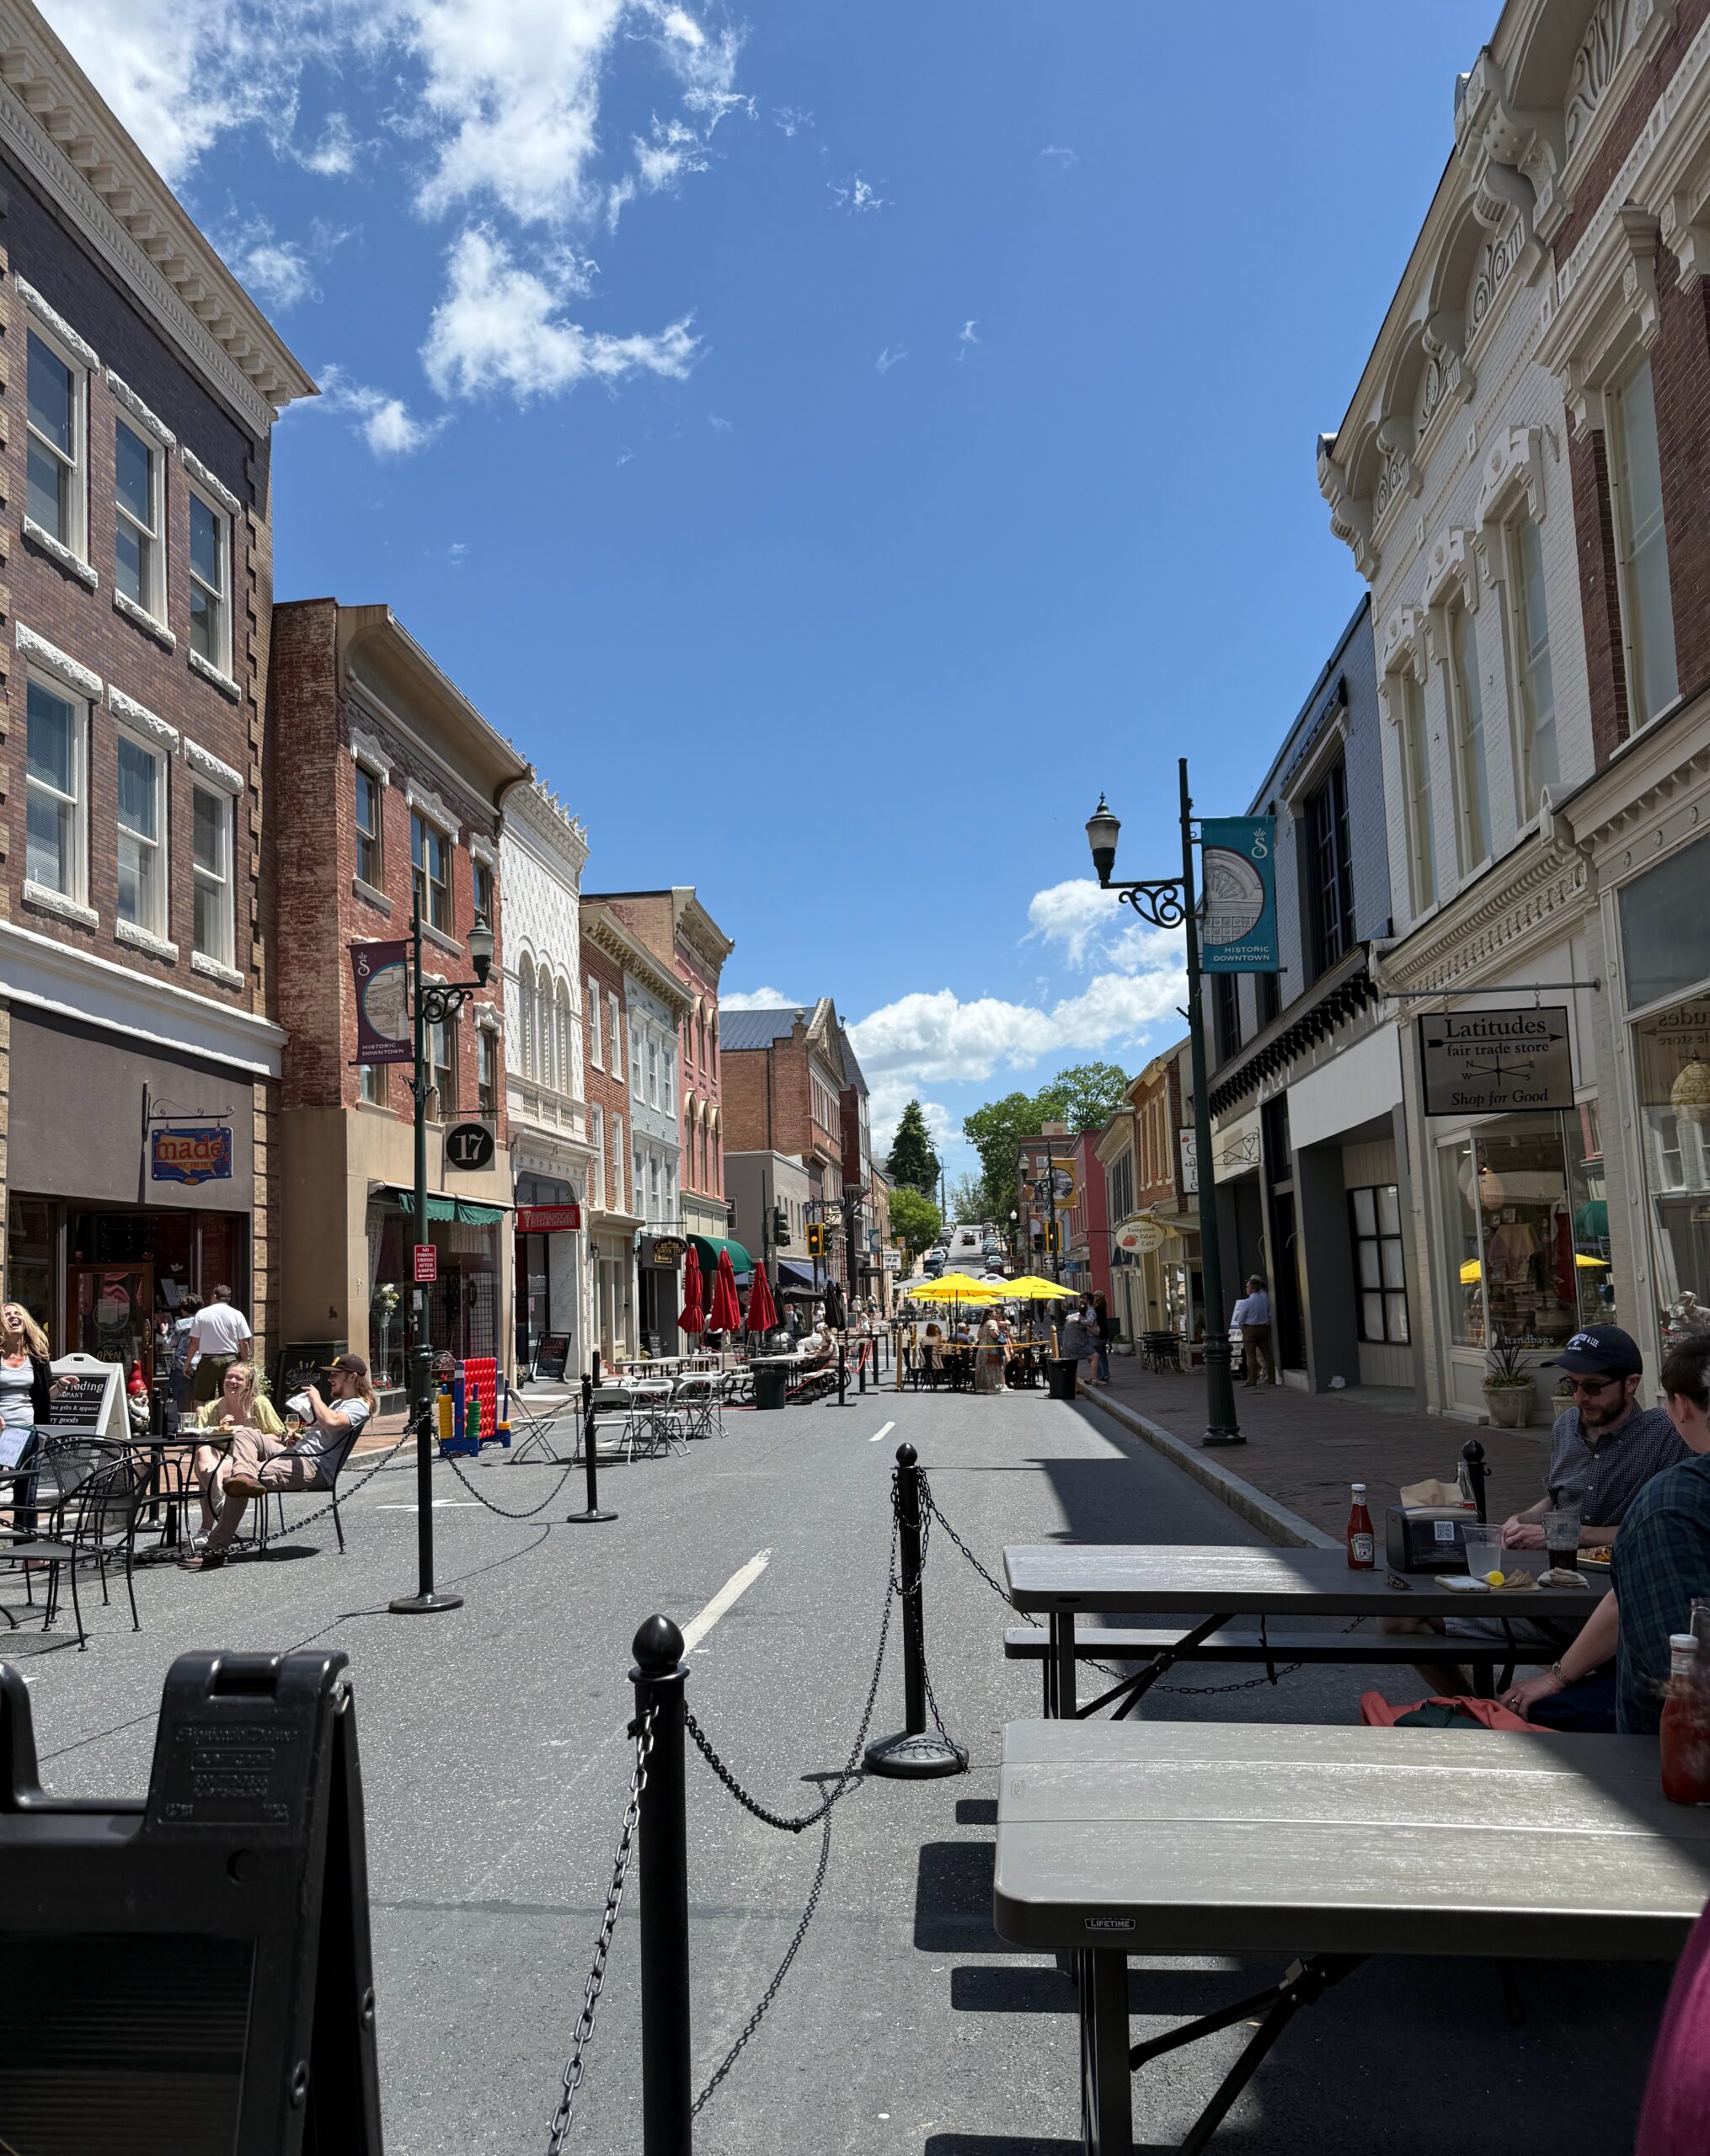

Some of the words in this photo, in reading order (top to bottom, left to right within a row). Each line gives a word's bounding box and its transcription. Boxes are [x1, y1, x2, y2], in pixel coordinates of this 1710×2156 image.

[1251, 836, 1268, 859] S
[1444, 1015, 1547, 1038] Latitudes
[1447, 1044, 1471, 1057] fair
[1476, 1042, 1510, 1055] trade
[1515, 1043, 1550, 1054] store
[1462, 1072, 1472, 1081] W
[1525, 1073, 1531, 1081] S
[1451, 1092, 1485, 1107] Shop
[1488, 1091, 1508, 1107] for
[1512, 1088, 1548, 1103] Good
[455, 1133, 485, 1161] 17
[1504, 1335, 1555, 1346] handbags
[1590, 1337, 1600, 1348] LEE
[97, 1349, 121, 1360] OPEN
[65, 1380, 104, 1394] ading
[59, 1416, 79, 1424] goods
[1091, 1919, 1130, 1928] LIFETIME
